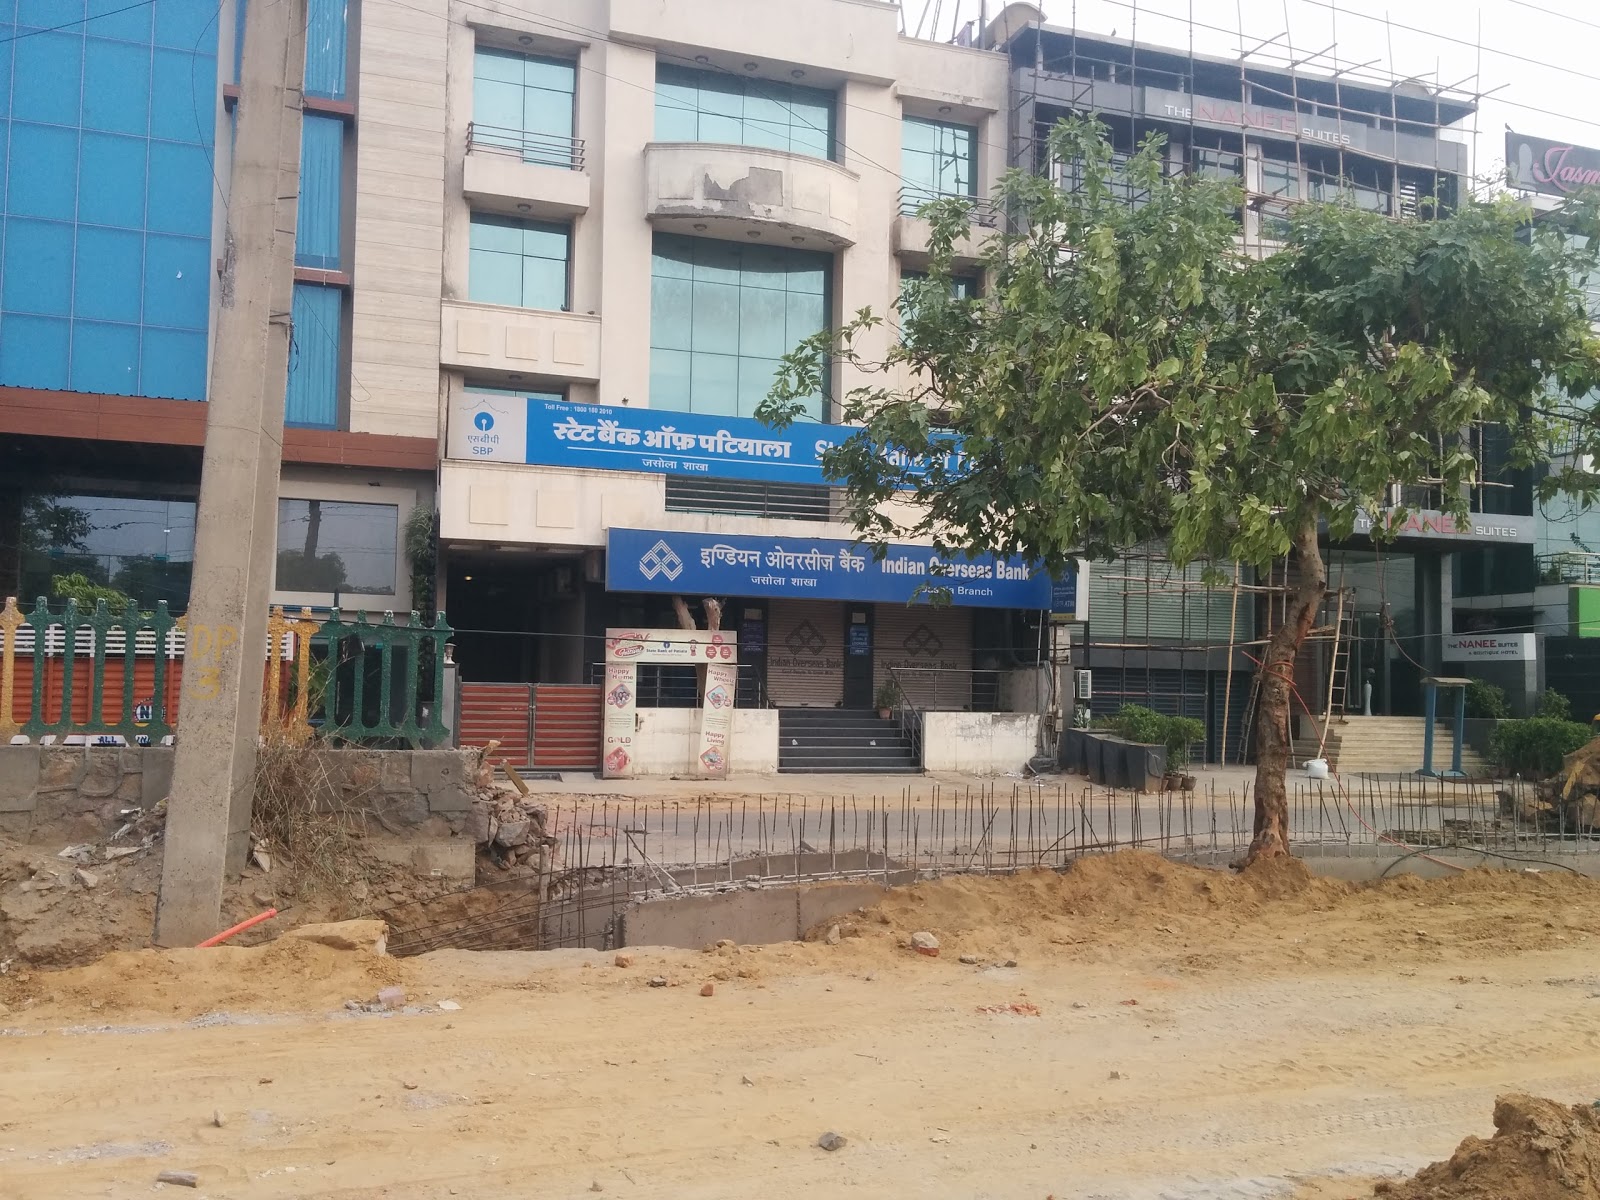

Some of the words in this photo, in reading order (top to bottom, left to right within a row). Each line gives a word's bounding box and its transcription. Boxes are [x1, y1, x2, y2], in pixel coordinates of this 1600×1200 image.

[1164, 104, 1192, 118] THE
[1198, 102, 1296, 132] NANEE
[1301, 127, 1351, 144] SUITES
[544, 403, 555, 411] Toll
[556, 404, 569, 412] Free
[553, 416, 596, 442] स्टेट
[597, 418, 641, 446] बैंक
[698, 429, 792, 459] पटियाला
[472, 446, 494, 455] SBP
[642, 457, 677, 469] जसोला
[682, 461, 709, 472] शाखा
[1475, 525, 1517, 537] SUITES
[700, 543, 762, 568] इण्डियन
[838, 548, 866, 573] बैंक
[881, 556, 925, 576] Indian
[996, 560, 1031, 581] Bank
[750, 573, 786, 586] जसोला
[791, 577, 818, 587] शाखा
[957, 586, 993, 597] Branch
[192, 623, 238, 662] DP
[1459, 639, 1497, 649] NANEE
[608, 667, 630, 675] Happy
[708, 669, 728, 677] Happy
[187, 667, 220, 700] 3
[98, 735, 118, 744] ALL
[607, 736, 632, 744] GOLD
[705, 731, 725, 739] Happy
[706, 737, 725, 745] Living
